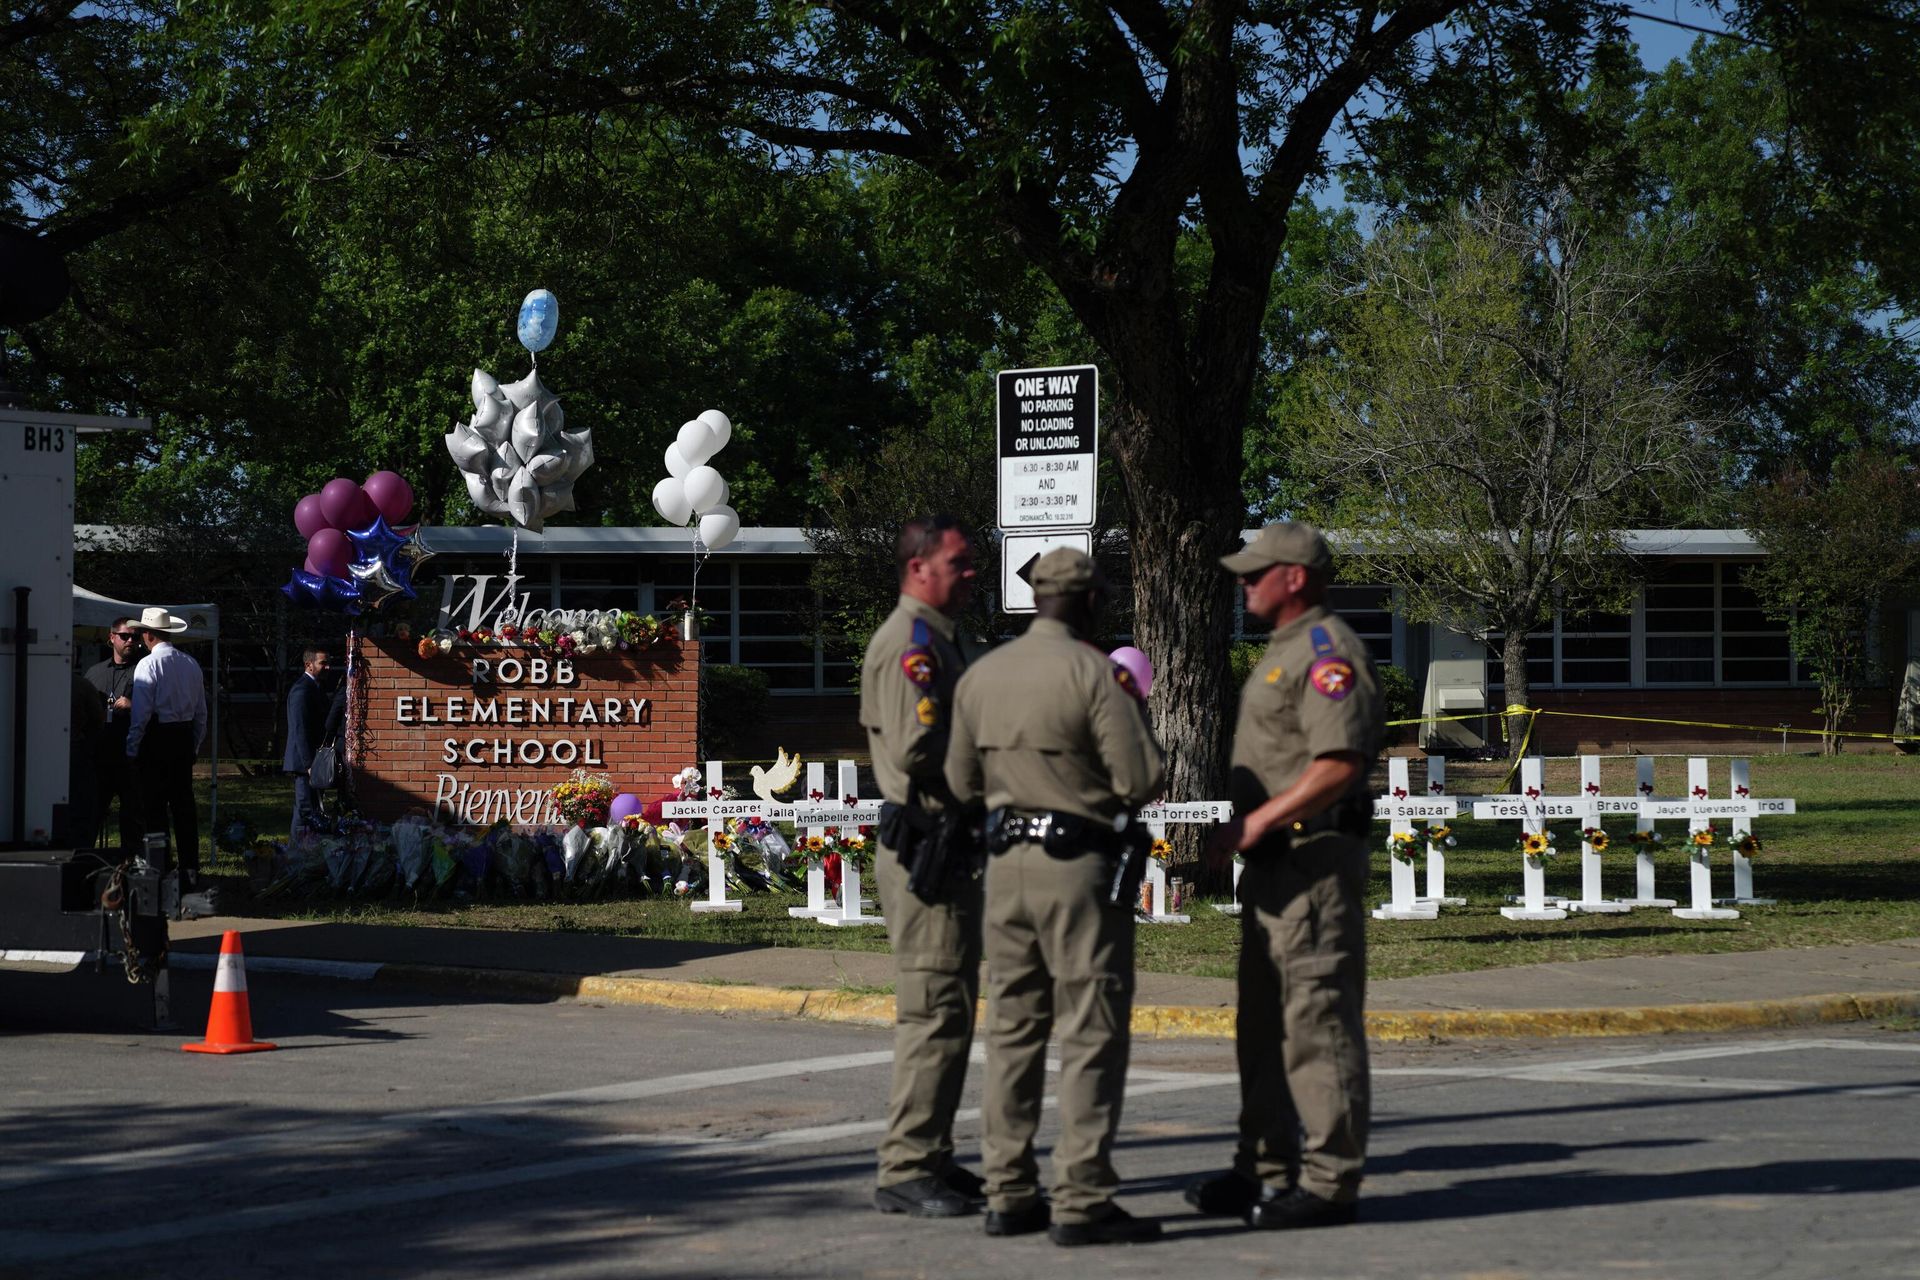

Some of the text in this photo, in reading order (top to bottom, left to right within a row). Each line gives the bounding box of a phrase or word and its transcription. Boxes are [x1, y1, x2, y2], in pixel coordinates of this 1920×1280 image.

[1015, 375, 1080, 397] ONE WAY
[1021, 398, 1074, 413] NO PARKING
[1021, 417, 1074, 432] NO LOADING
[24, 426, 65, 452] BH3
[1015, 435, 1080, 451] OR UNLOADING
[1046, 462, 1064, 472] 8:30
[1066, 459, 1079, 472] AM
[1038, 478, 1056, 490] AND
[1021, 497, 1039, 507] 2:30
[1046, 496, 1064, 506] 3:30
[1065, 494, 1078, 506] PM
[472, 658, 575, 684] ROBB
[396, 696, 646, 724] ELEMENTARY
[442, 738, 601, 764] SCHOOL
[1397, 806, 1451, 817] Salazar
[1491, 805, 1574, 816] Tess Mata
[1597, 801, 1639, 811] Bravo
[1656, 804, 1748, 815] Jayce Luevanos
[767, 808, 800, 818] Jaila
[796, 813, 850, 824] Annabelle
[1163, 809, 1208, 819] Torres
